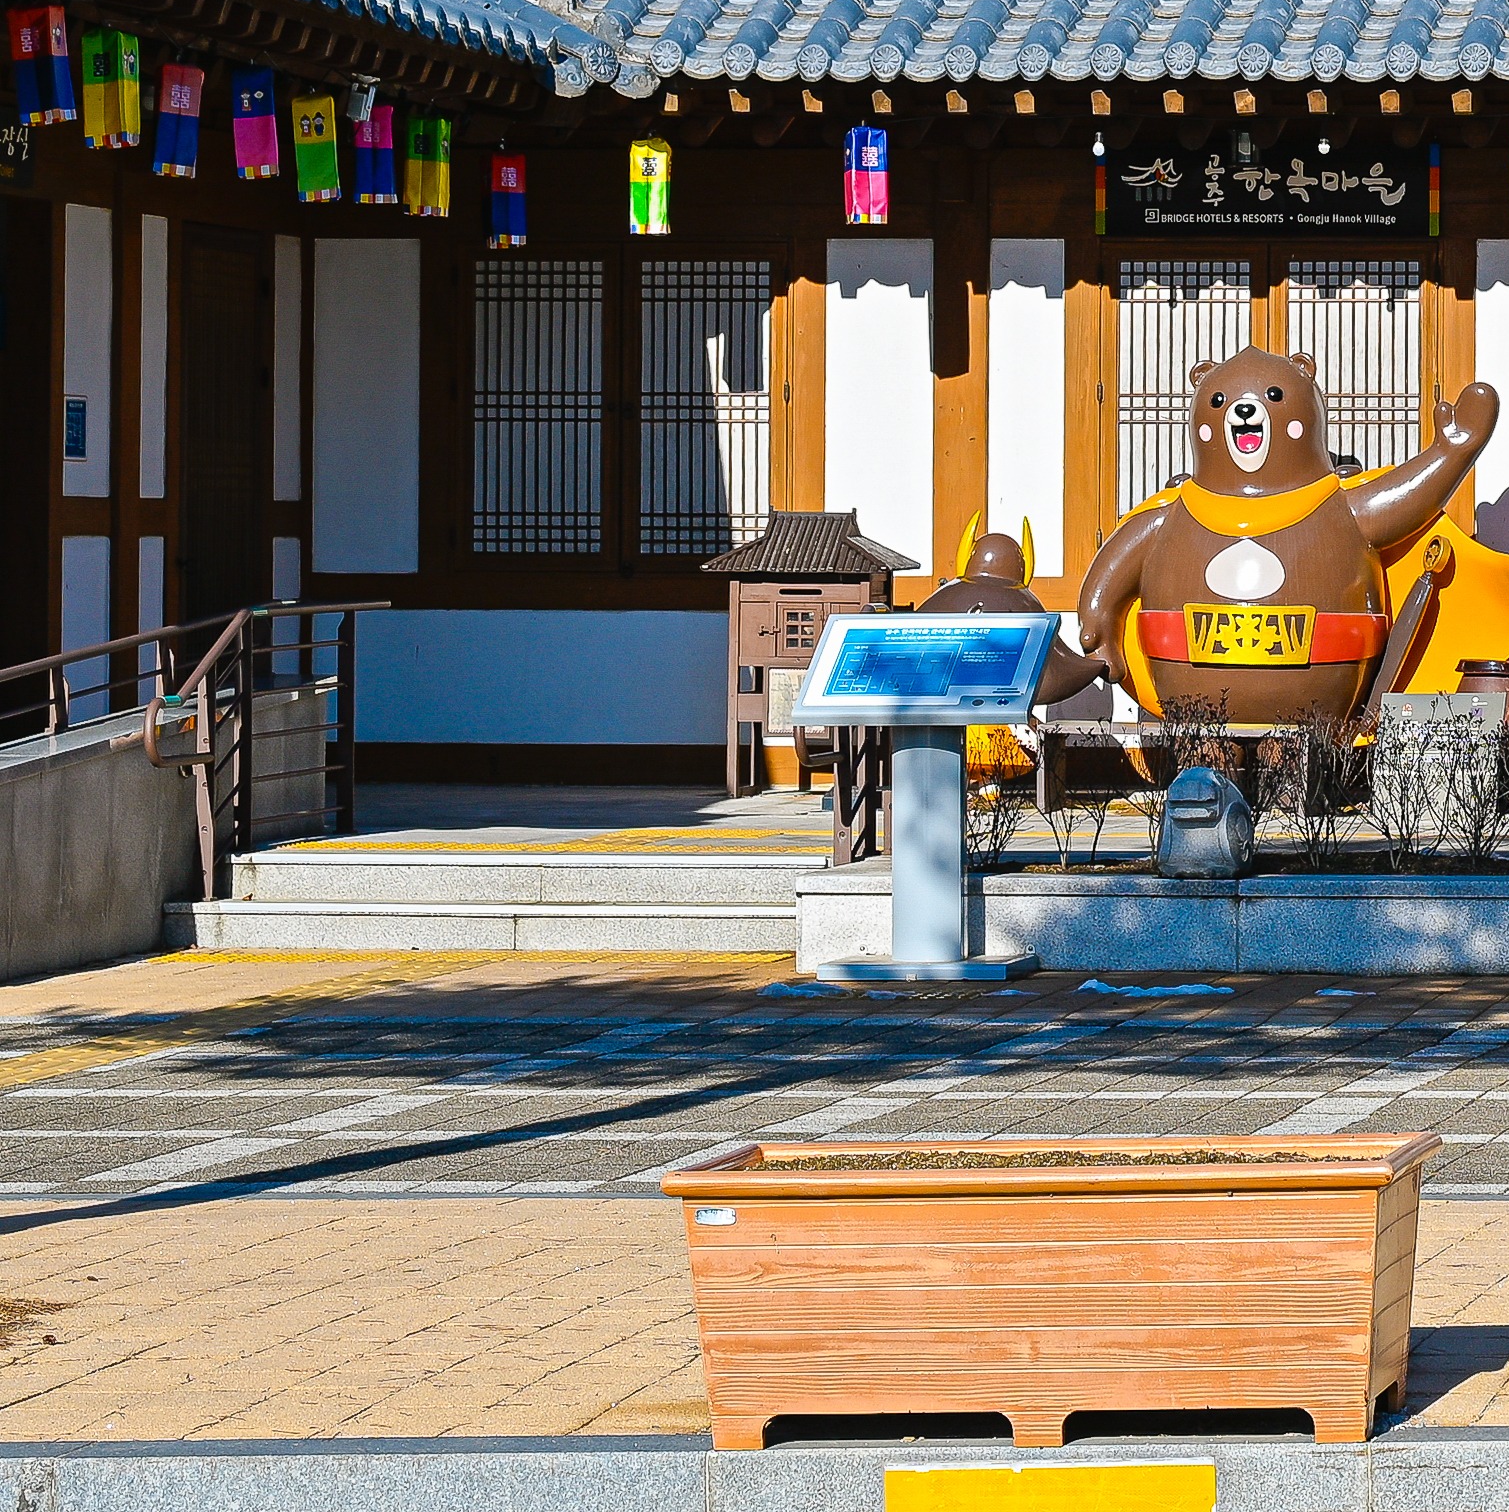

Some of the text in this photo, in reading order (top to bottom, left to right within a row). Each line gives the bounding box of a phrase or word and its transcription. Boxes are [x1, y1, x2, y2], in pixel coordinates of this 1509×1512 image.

[0, 126, 29, 161] 장실
[1202, 154, 1406, 206] 공주 한옥마을
[1161, 213, 1397, 225] BRIDGE HOTELS & RESORTS Gongju Hanok Village
